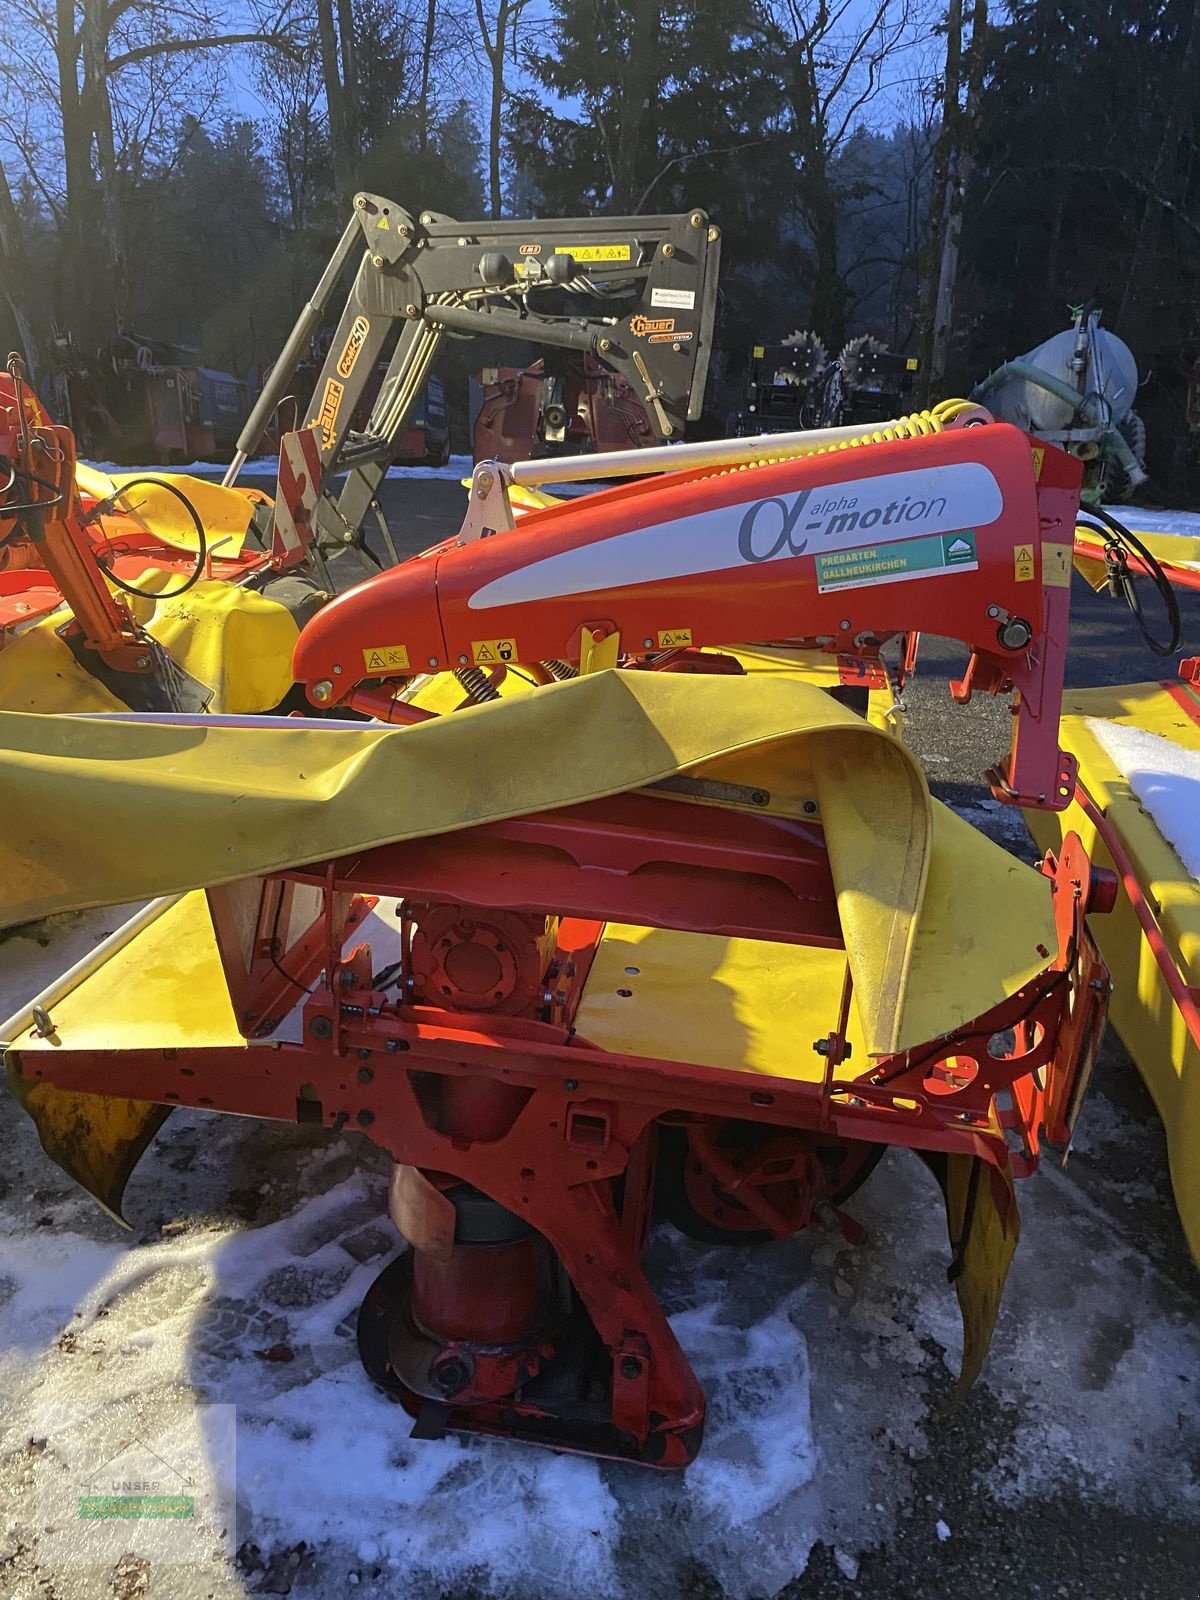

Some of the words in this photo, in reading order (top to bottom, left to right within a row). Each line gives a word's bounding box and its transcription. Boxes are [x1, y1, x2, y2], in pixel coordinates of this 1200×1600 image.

[636, 320, 672, 332] hauer
[810, 497, 858, 516] alpha
[821, 549, 877, 566] PREGARTEN
[823, 558, 908, 579] GALLNEUKIRCHEN
